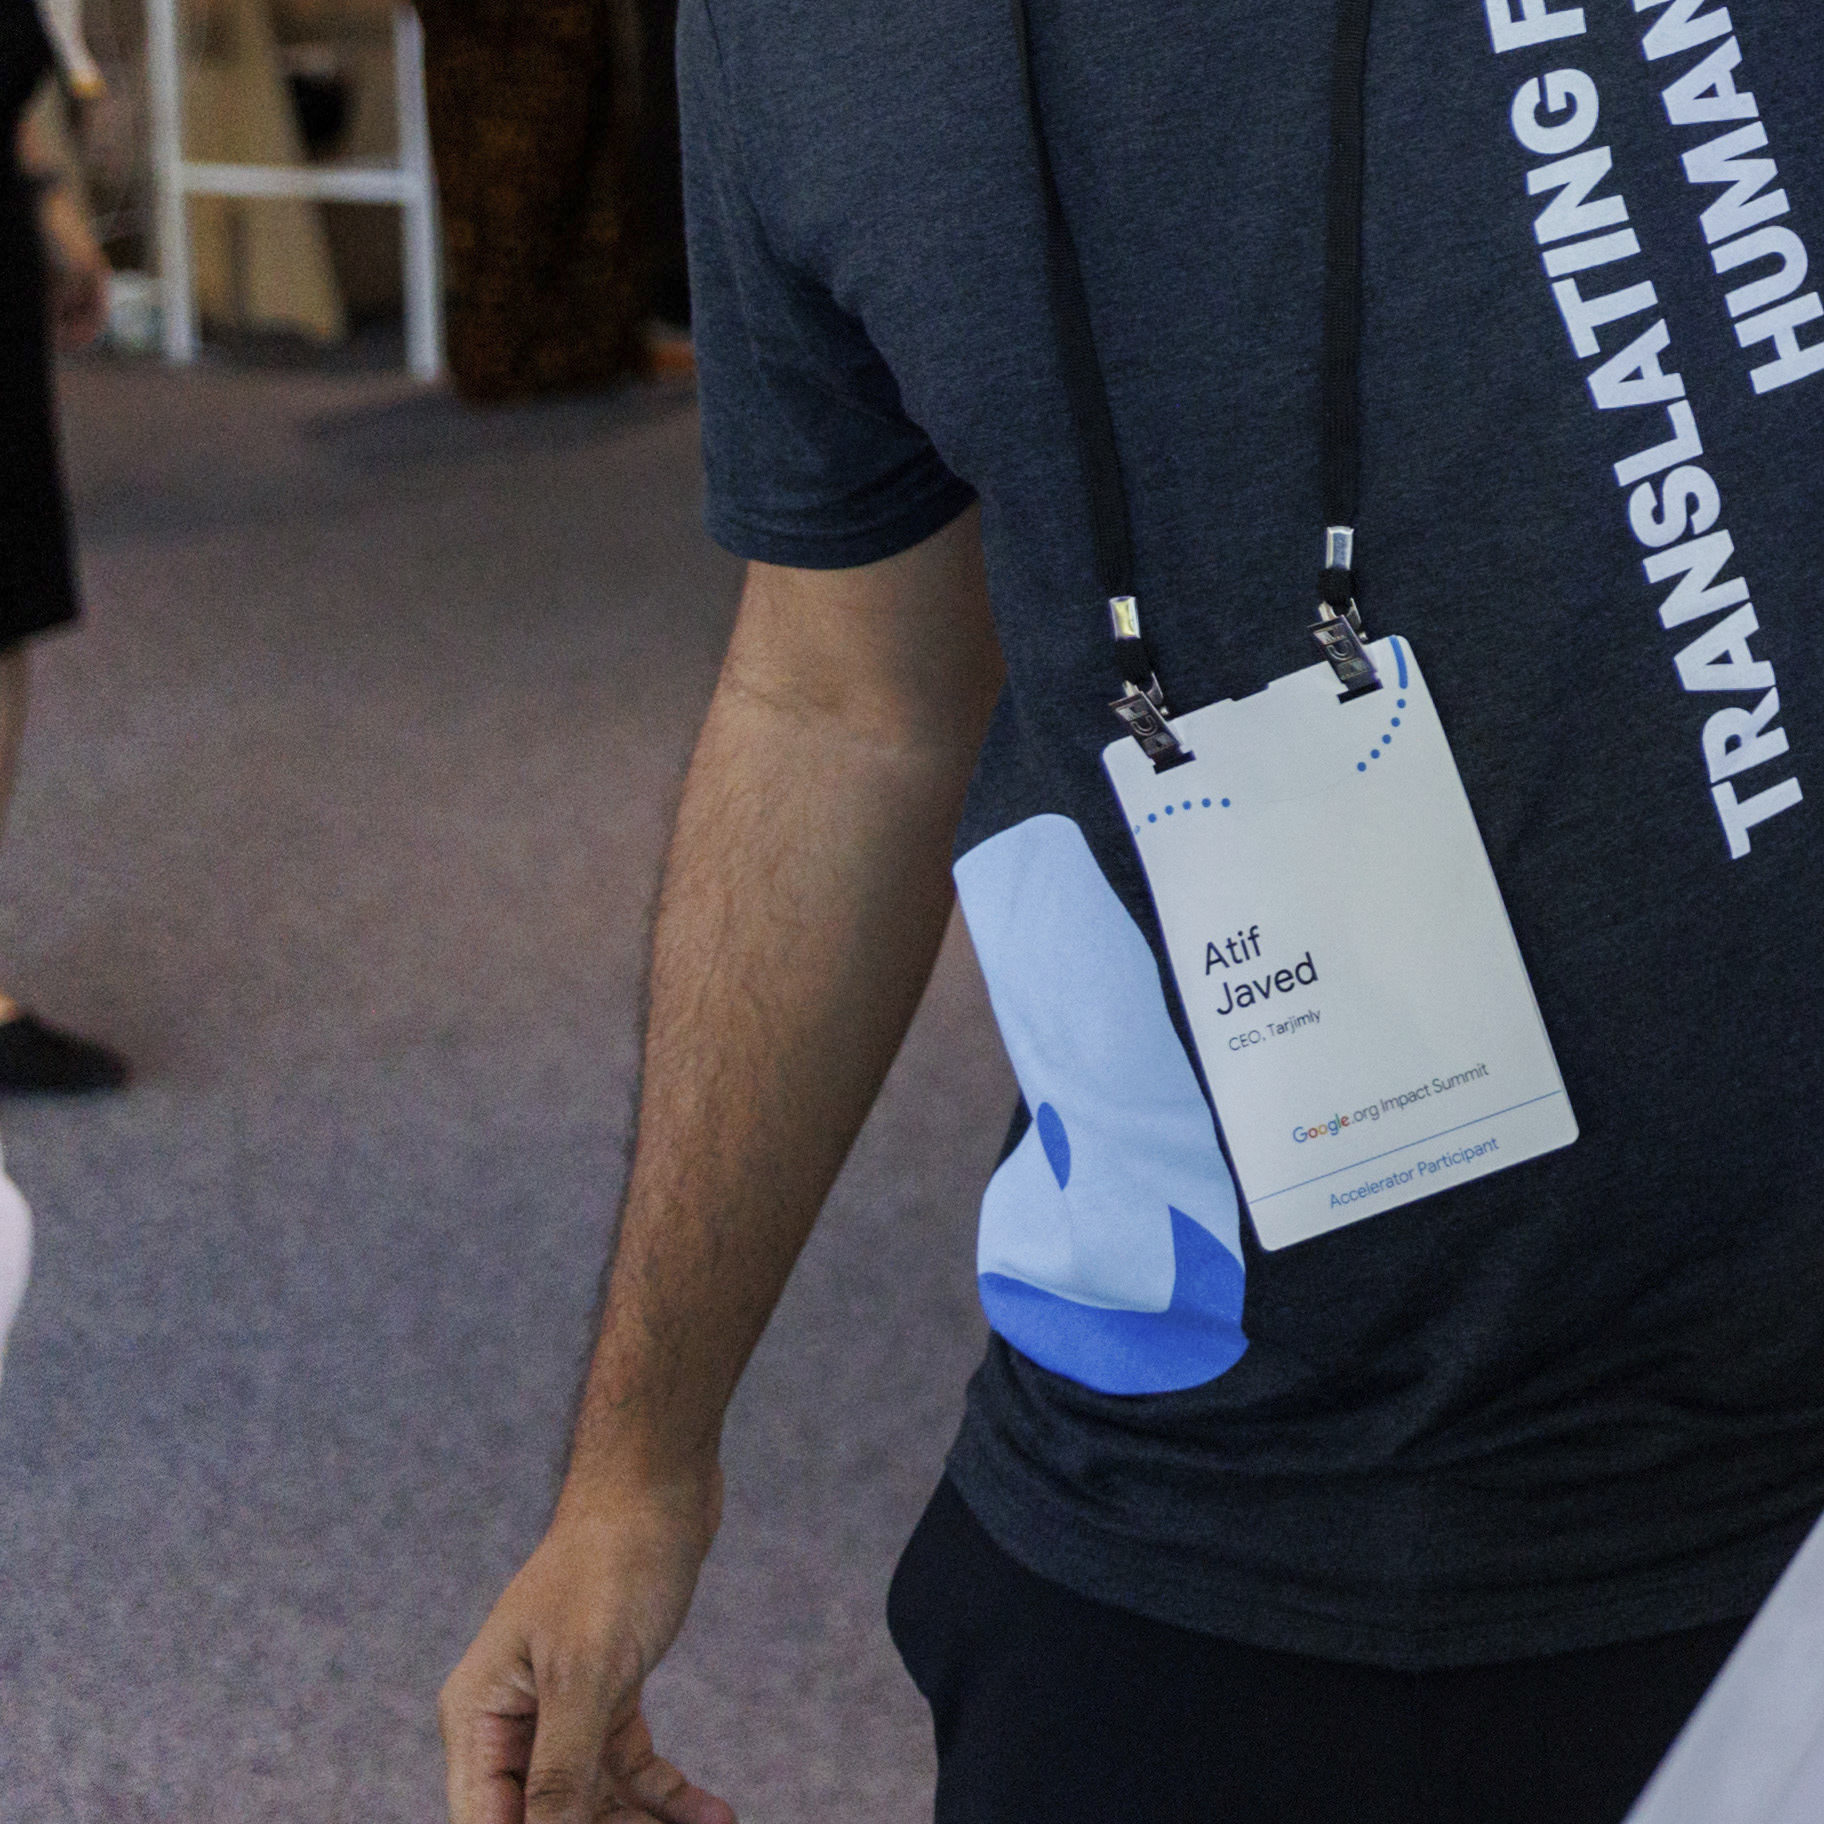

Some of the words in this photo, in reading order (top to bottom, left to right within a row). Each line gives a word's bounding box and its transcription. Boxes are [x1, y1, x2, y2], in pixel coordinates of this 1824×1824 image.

[1511, 67, 1804, 860] TRANSLATING
[1205, 924, 1262, 976] Atif
[1216, 951, 1319, 1016] Javed
[1266, 1008, 1321, 1038] Tarjimly
[1292, 1102, 1381, 1144] Google.org
[1380, 1084, 1432, 1114] Impact
[1431, 1061, 1490, 1094] Summit
[1329, 1168, 1416, 1210] Accelerator
[1416, 1137, 1500, 1176] Participant
